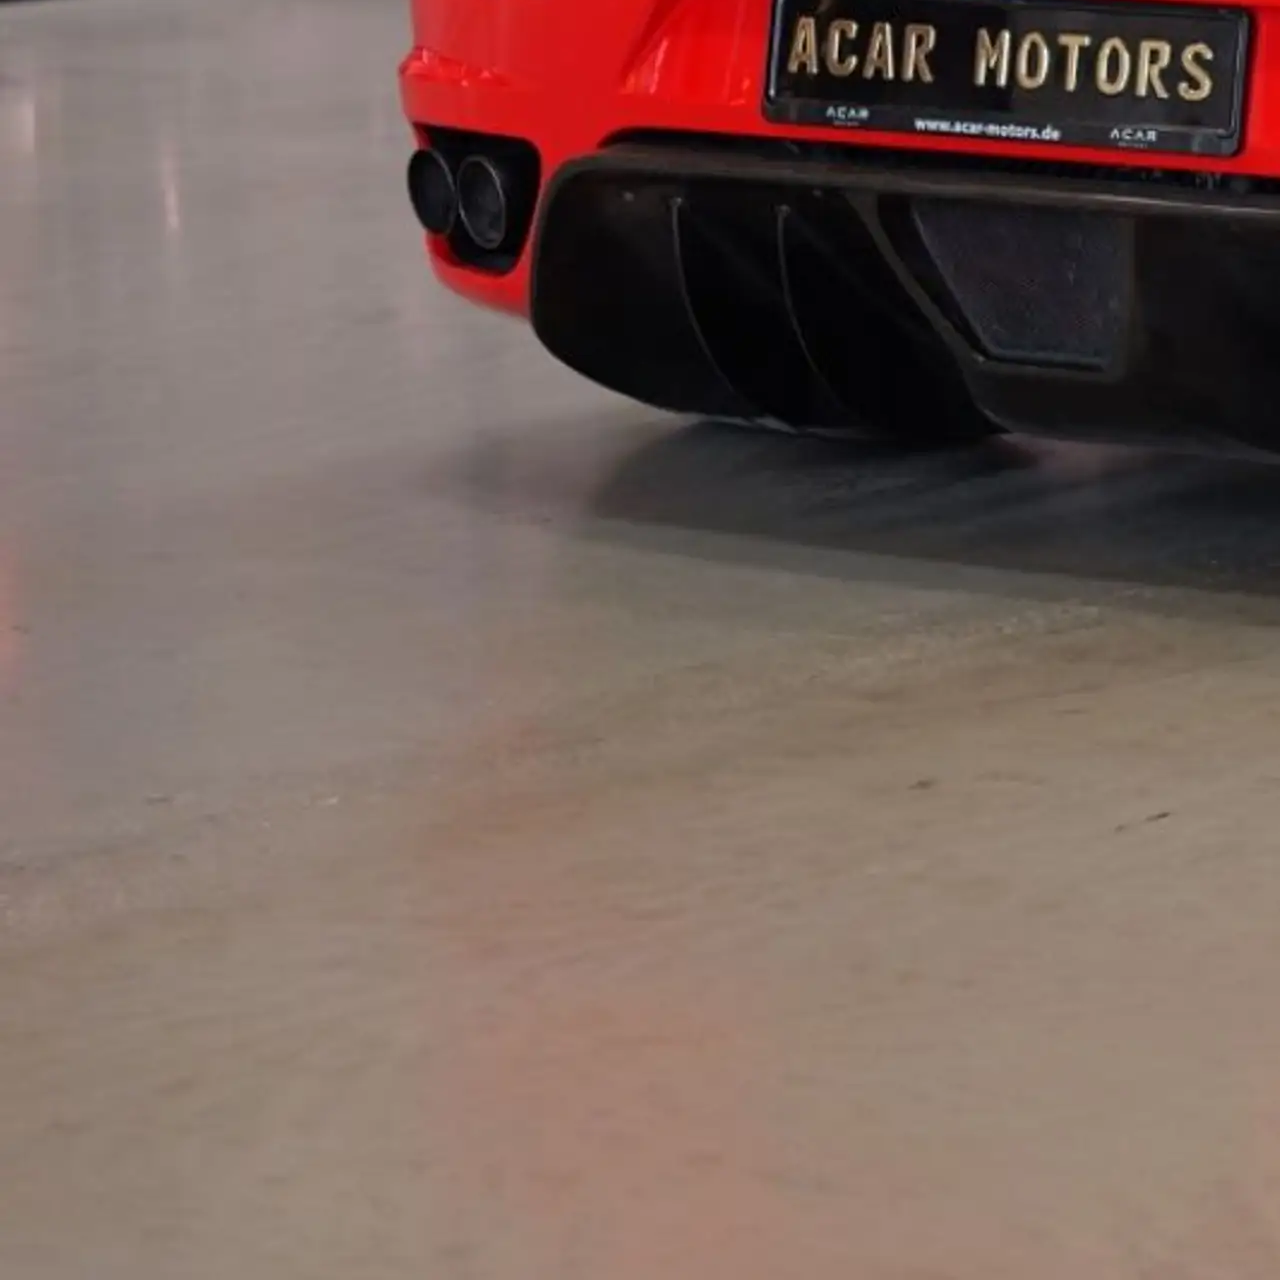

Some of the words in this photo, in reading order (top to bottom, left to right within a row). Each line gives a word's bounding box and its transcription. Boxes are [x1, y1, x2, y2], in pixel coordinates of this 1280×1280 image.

[787, 15, 936, 83] ACAR
[973, 26, 1215, 102] MOTORS
[825, 105, 870, 119] ACAR
[913, 117, 1062, 141] www.acar-motors.de
[1108, 127, 1157, 142] ACAR
